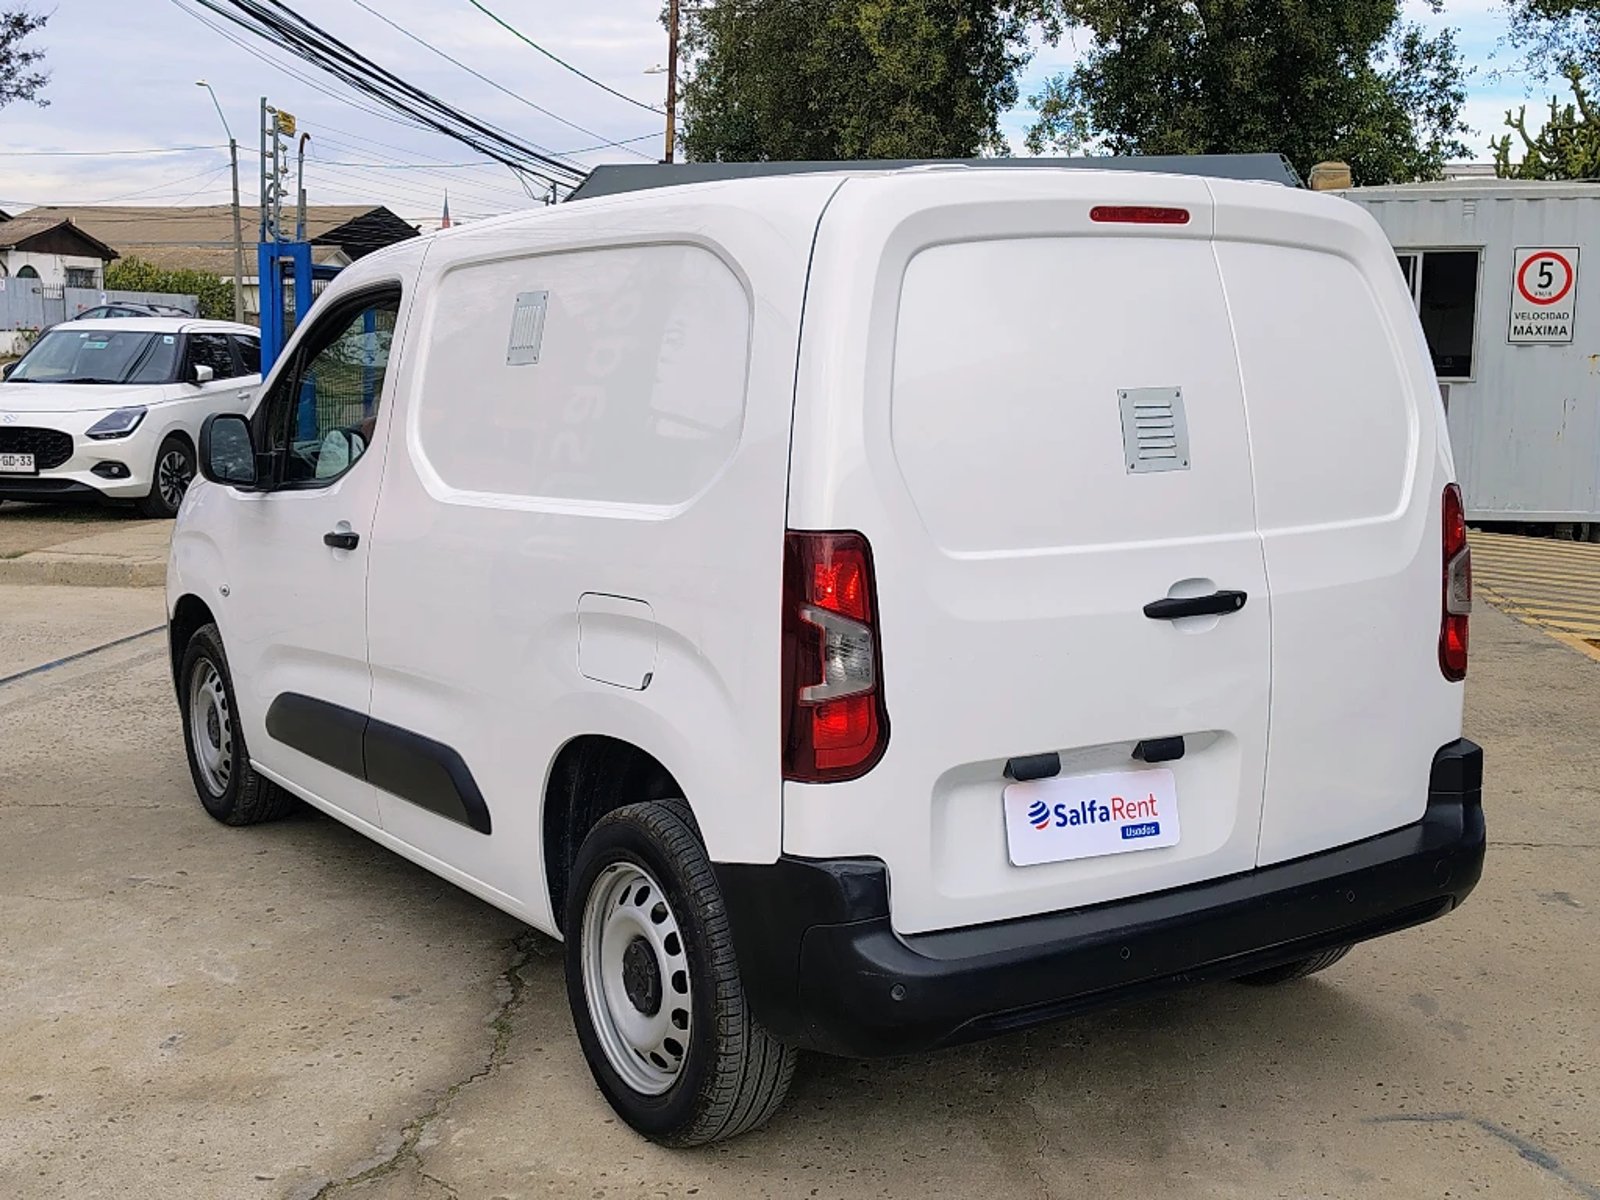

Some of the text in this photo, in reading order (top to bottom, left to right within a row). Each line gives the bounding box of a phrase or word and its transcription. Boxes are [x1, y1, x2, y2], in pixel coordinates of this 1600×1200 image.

[1537, 261, 1554, 289] 5
[1514, 312, 1570, 320] VELOCIDAD
[1513, 322, 1568, 336] MÁXIMA
[1054, 793, 1158, 827] SalfaRent
[1126, 824, 1156, 837] Usados
